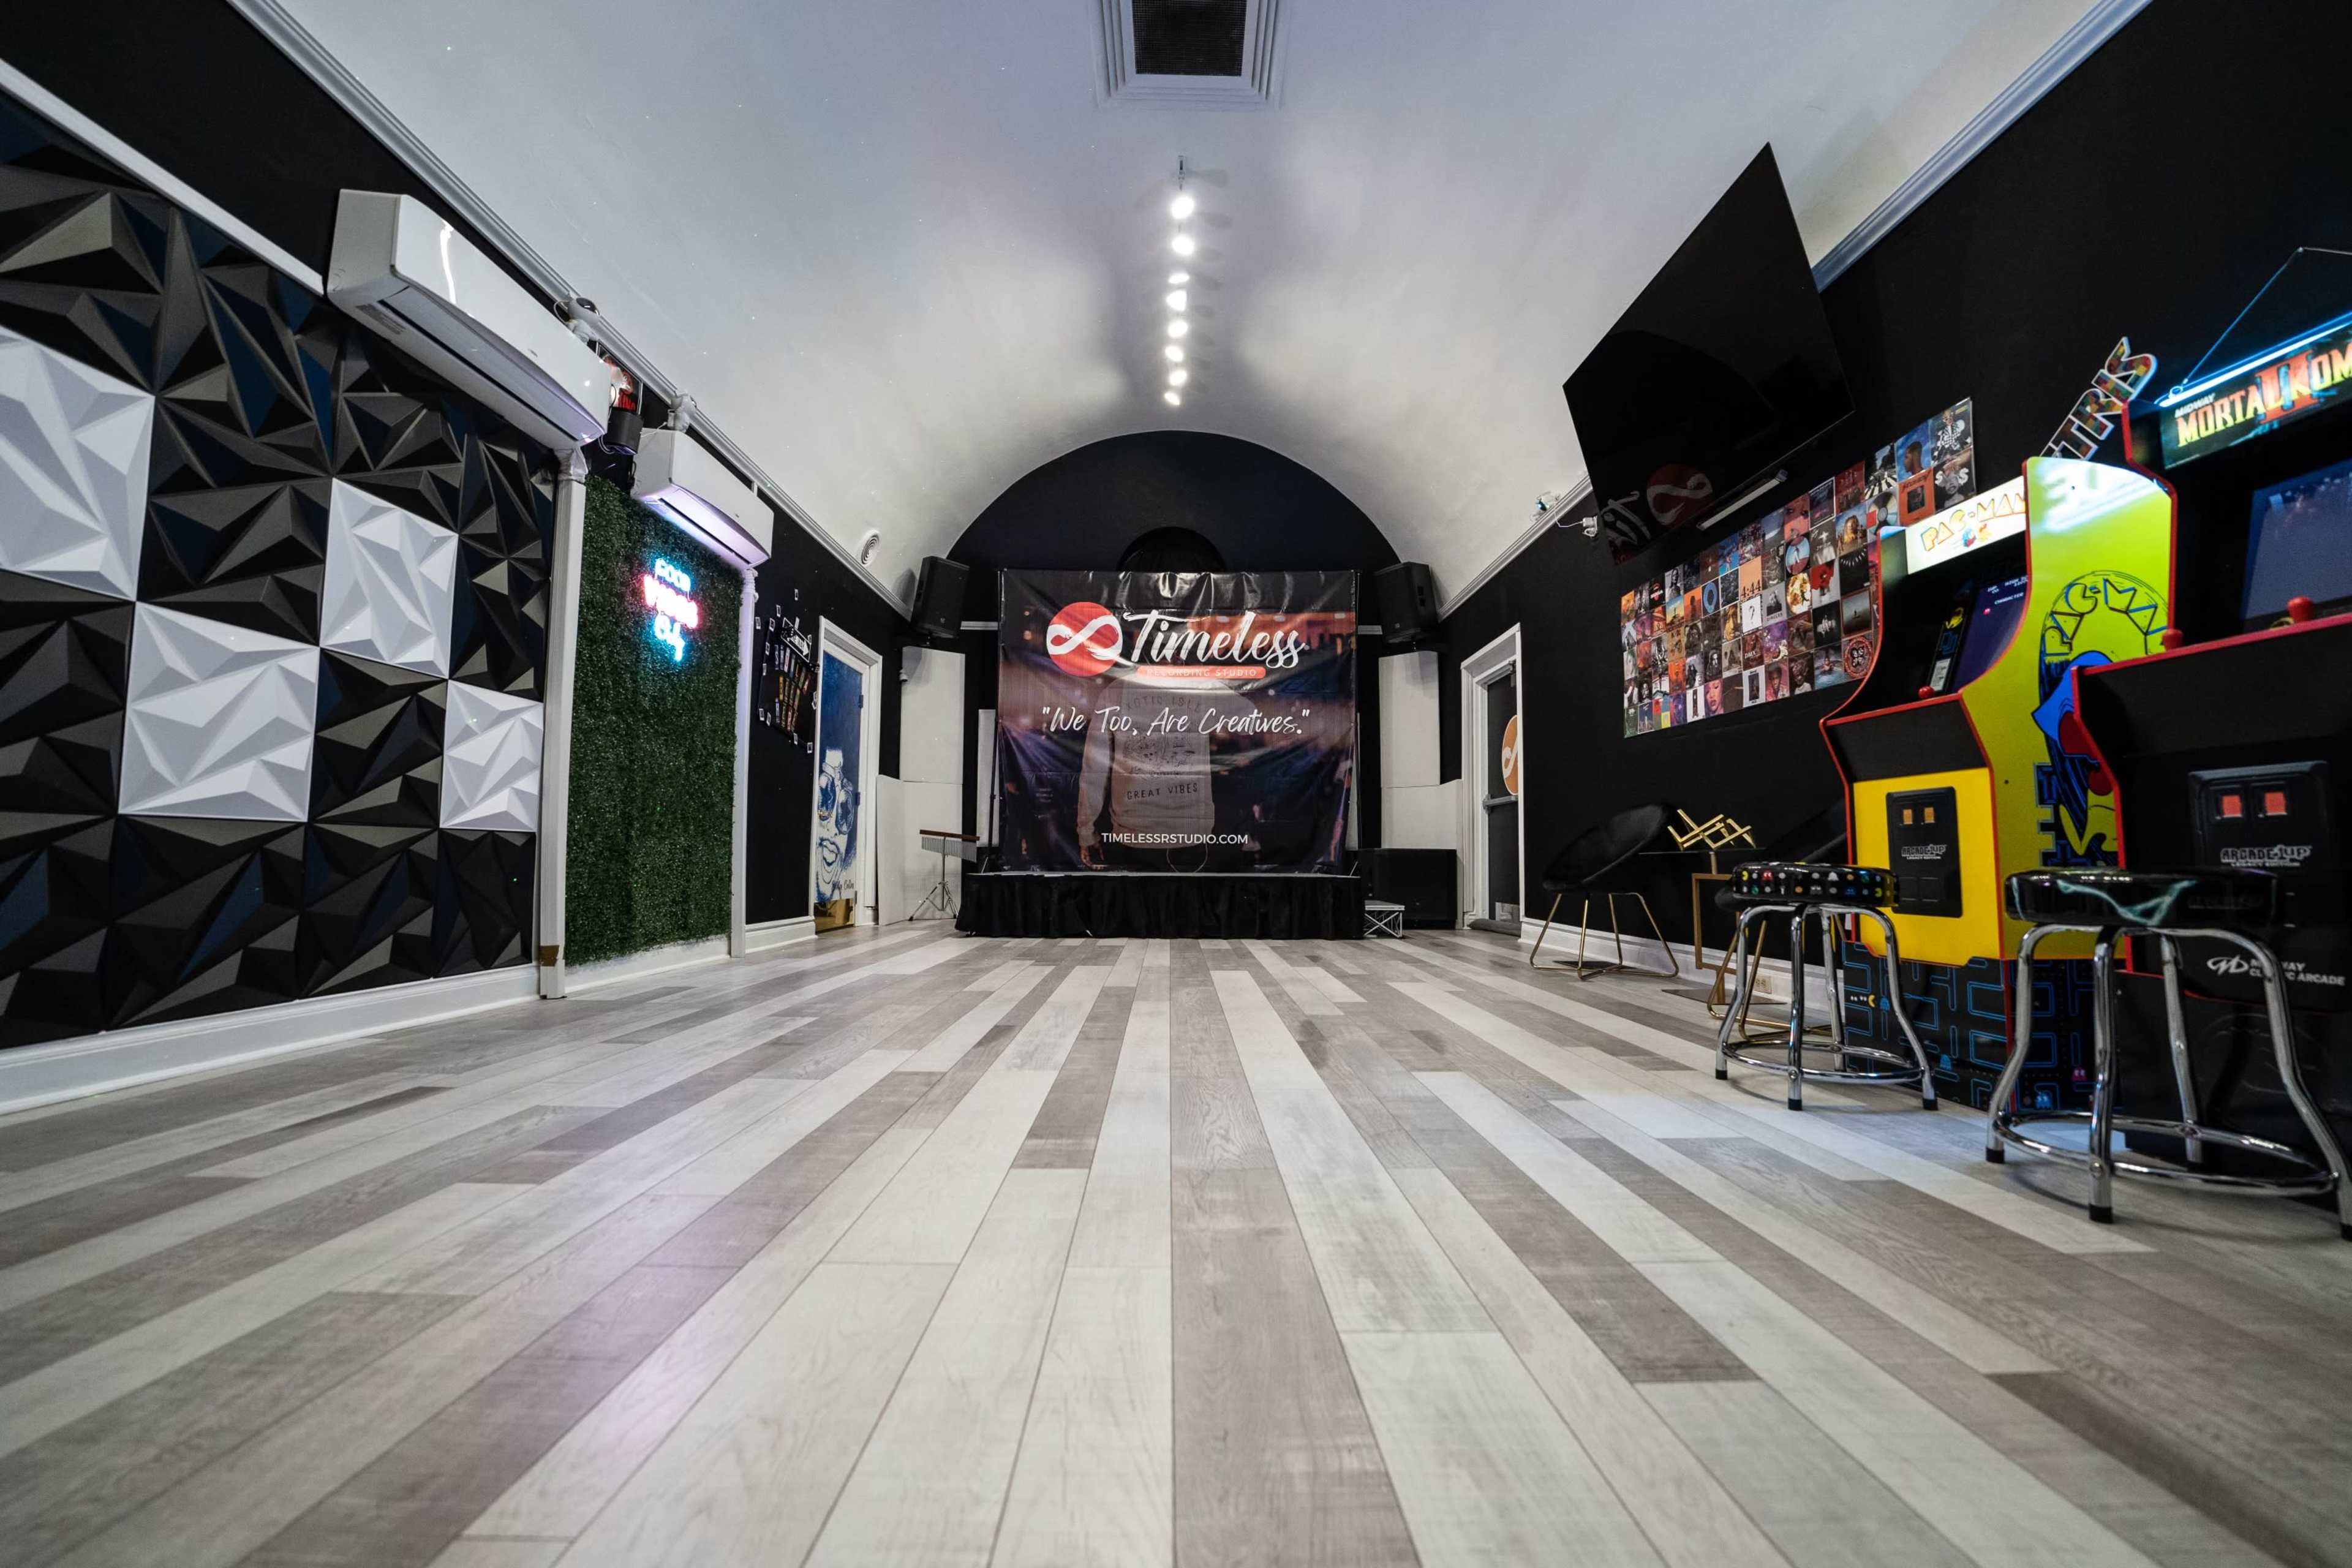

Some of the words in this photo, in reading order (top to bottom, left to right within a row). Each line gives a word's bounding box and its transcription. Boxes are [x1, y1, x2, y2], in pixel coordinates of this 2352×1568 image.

[2174, 392, 2216, 418] MIDWAY
[2176, 371, 2286, 447] MORTAL
[1741, 579, 1761, 598] 4:44
[1123, 609, 1306, 669] Timeless
[1147, 668, 1210, 677] RECORDING
[1215, 668, 1256, 677] STUDIO
[1095, 706, 1138, 736] Too,
[1147, 708, 1190, 736] Are
[1198, 708, 1310, 735] Creatives."
[1127, 788, 1160, 800] GREAT
[1167, 782, 1198, 794] VIBES
[1101, 832, 1249, 845] TIMELESSRSTUDIO.COM
[2297, 973, 2346, 986] ARCADE
